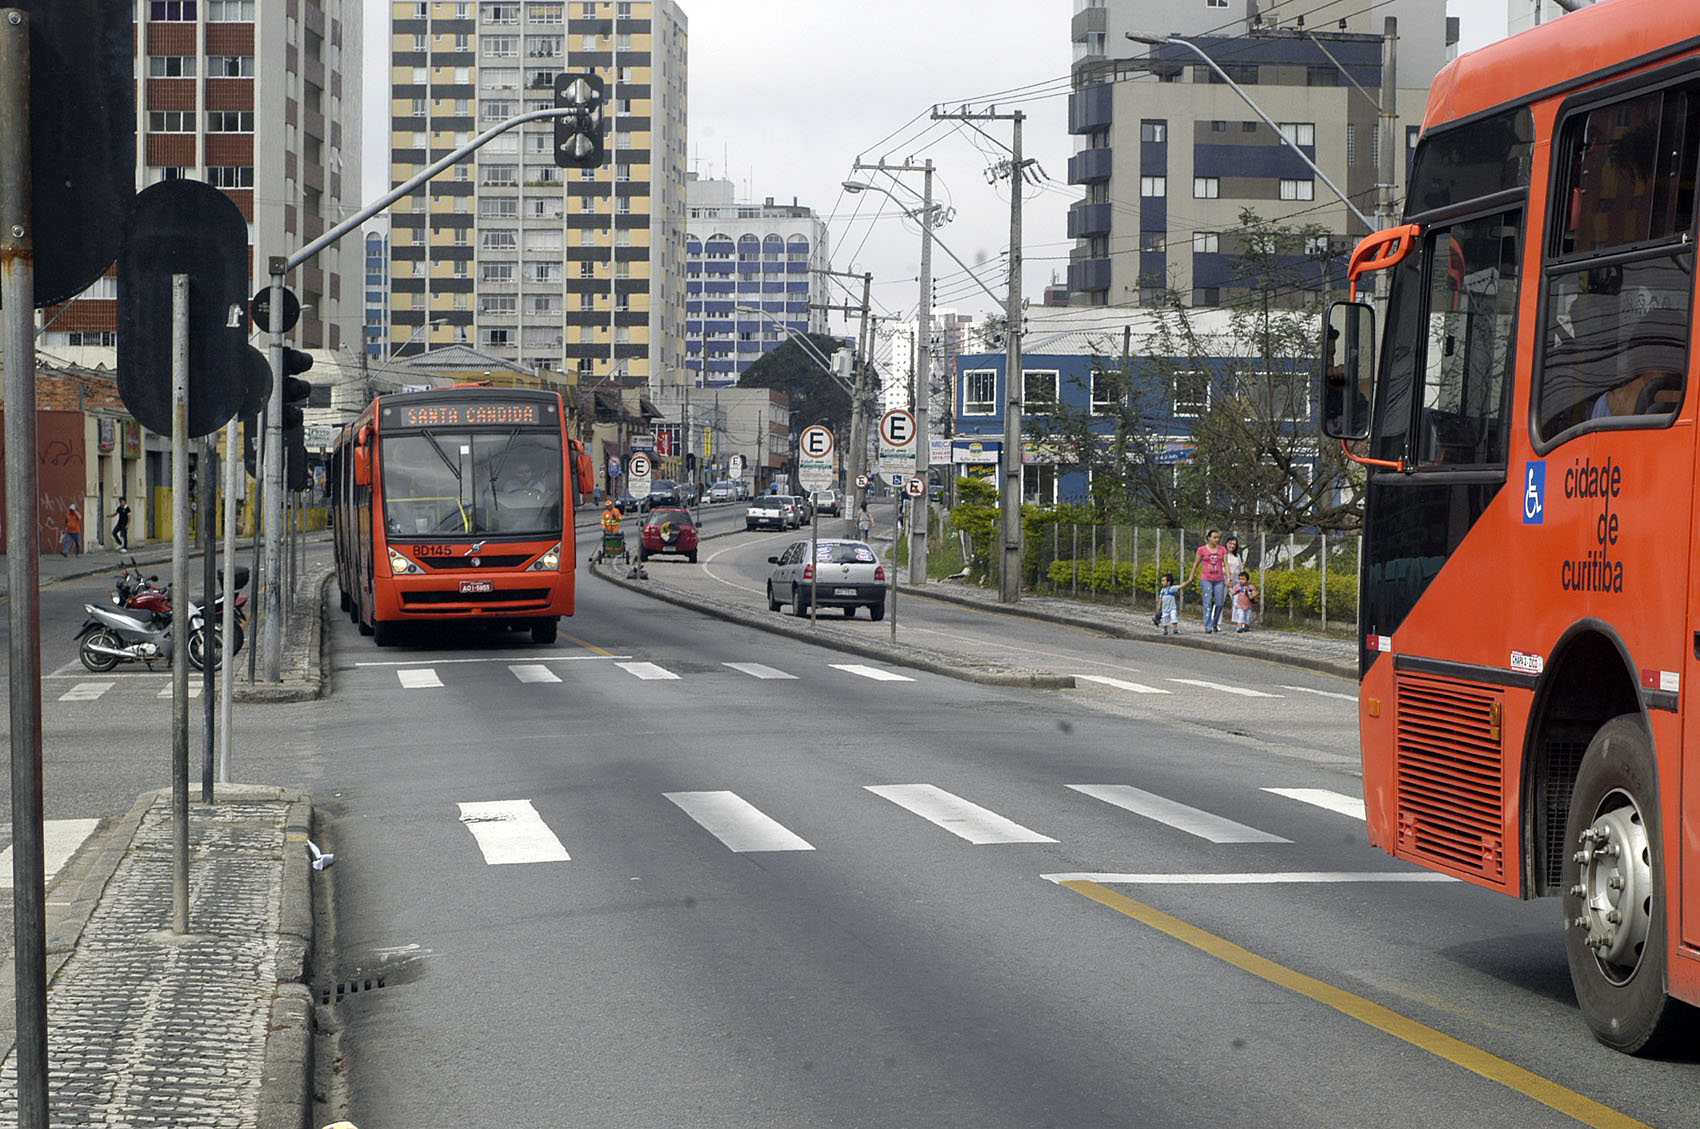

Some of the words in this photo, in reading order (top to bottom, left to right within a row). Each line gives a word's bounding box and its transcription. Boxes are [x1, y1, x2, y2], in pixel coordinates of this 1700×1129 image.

[407, 408, 459, 425] SANTA
[466, 405, 534, 423] CANDIDA
[890, 416, 906, 440] E
[809, 432, 824, 452] E
[635, 460, 645, 473] E
[733, 456, 739, 465] E
[1564, 456, 1621, 499] cidade
[1597, 512, 1619, 545] de
[413, 545, 453, 556] BD145
[1562, 550, 1623, 593] curitiba
